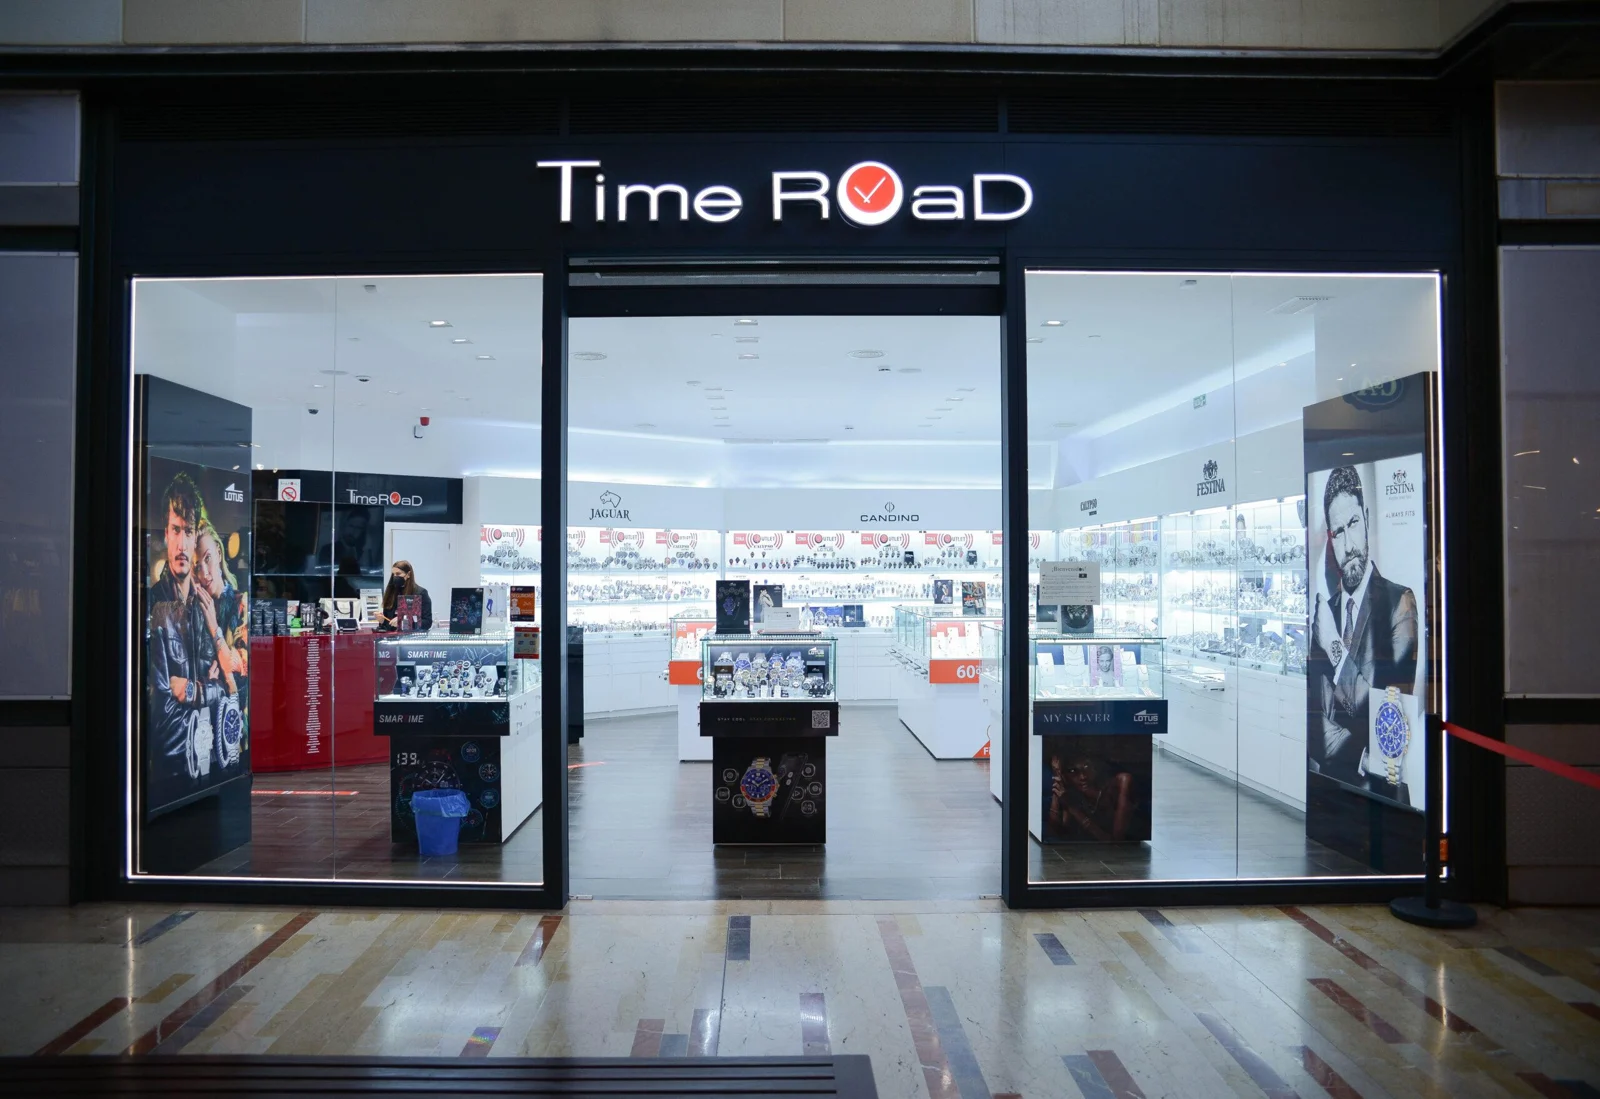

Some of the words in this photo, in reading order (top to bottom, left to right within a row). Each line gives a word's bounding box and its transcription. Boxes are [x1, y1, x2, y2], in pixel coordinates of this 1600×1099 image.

[537, 161, 743, 222] Time
[1196, 479, 1226, 497] FESTINA
[1385, 483, 1415, 495] FESTINA
[225, 491, 243, 502] LOTUS
[589, 508, 631, 521] JAGUAR
[860, 514, 919, 522] CANDINO
[1043, 714, 1061, 722] MY
[1065, 713, 1110, 722] SILVER
